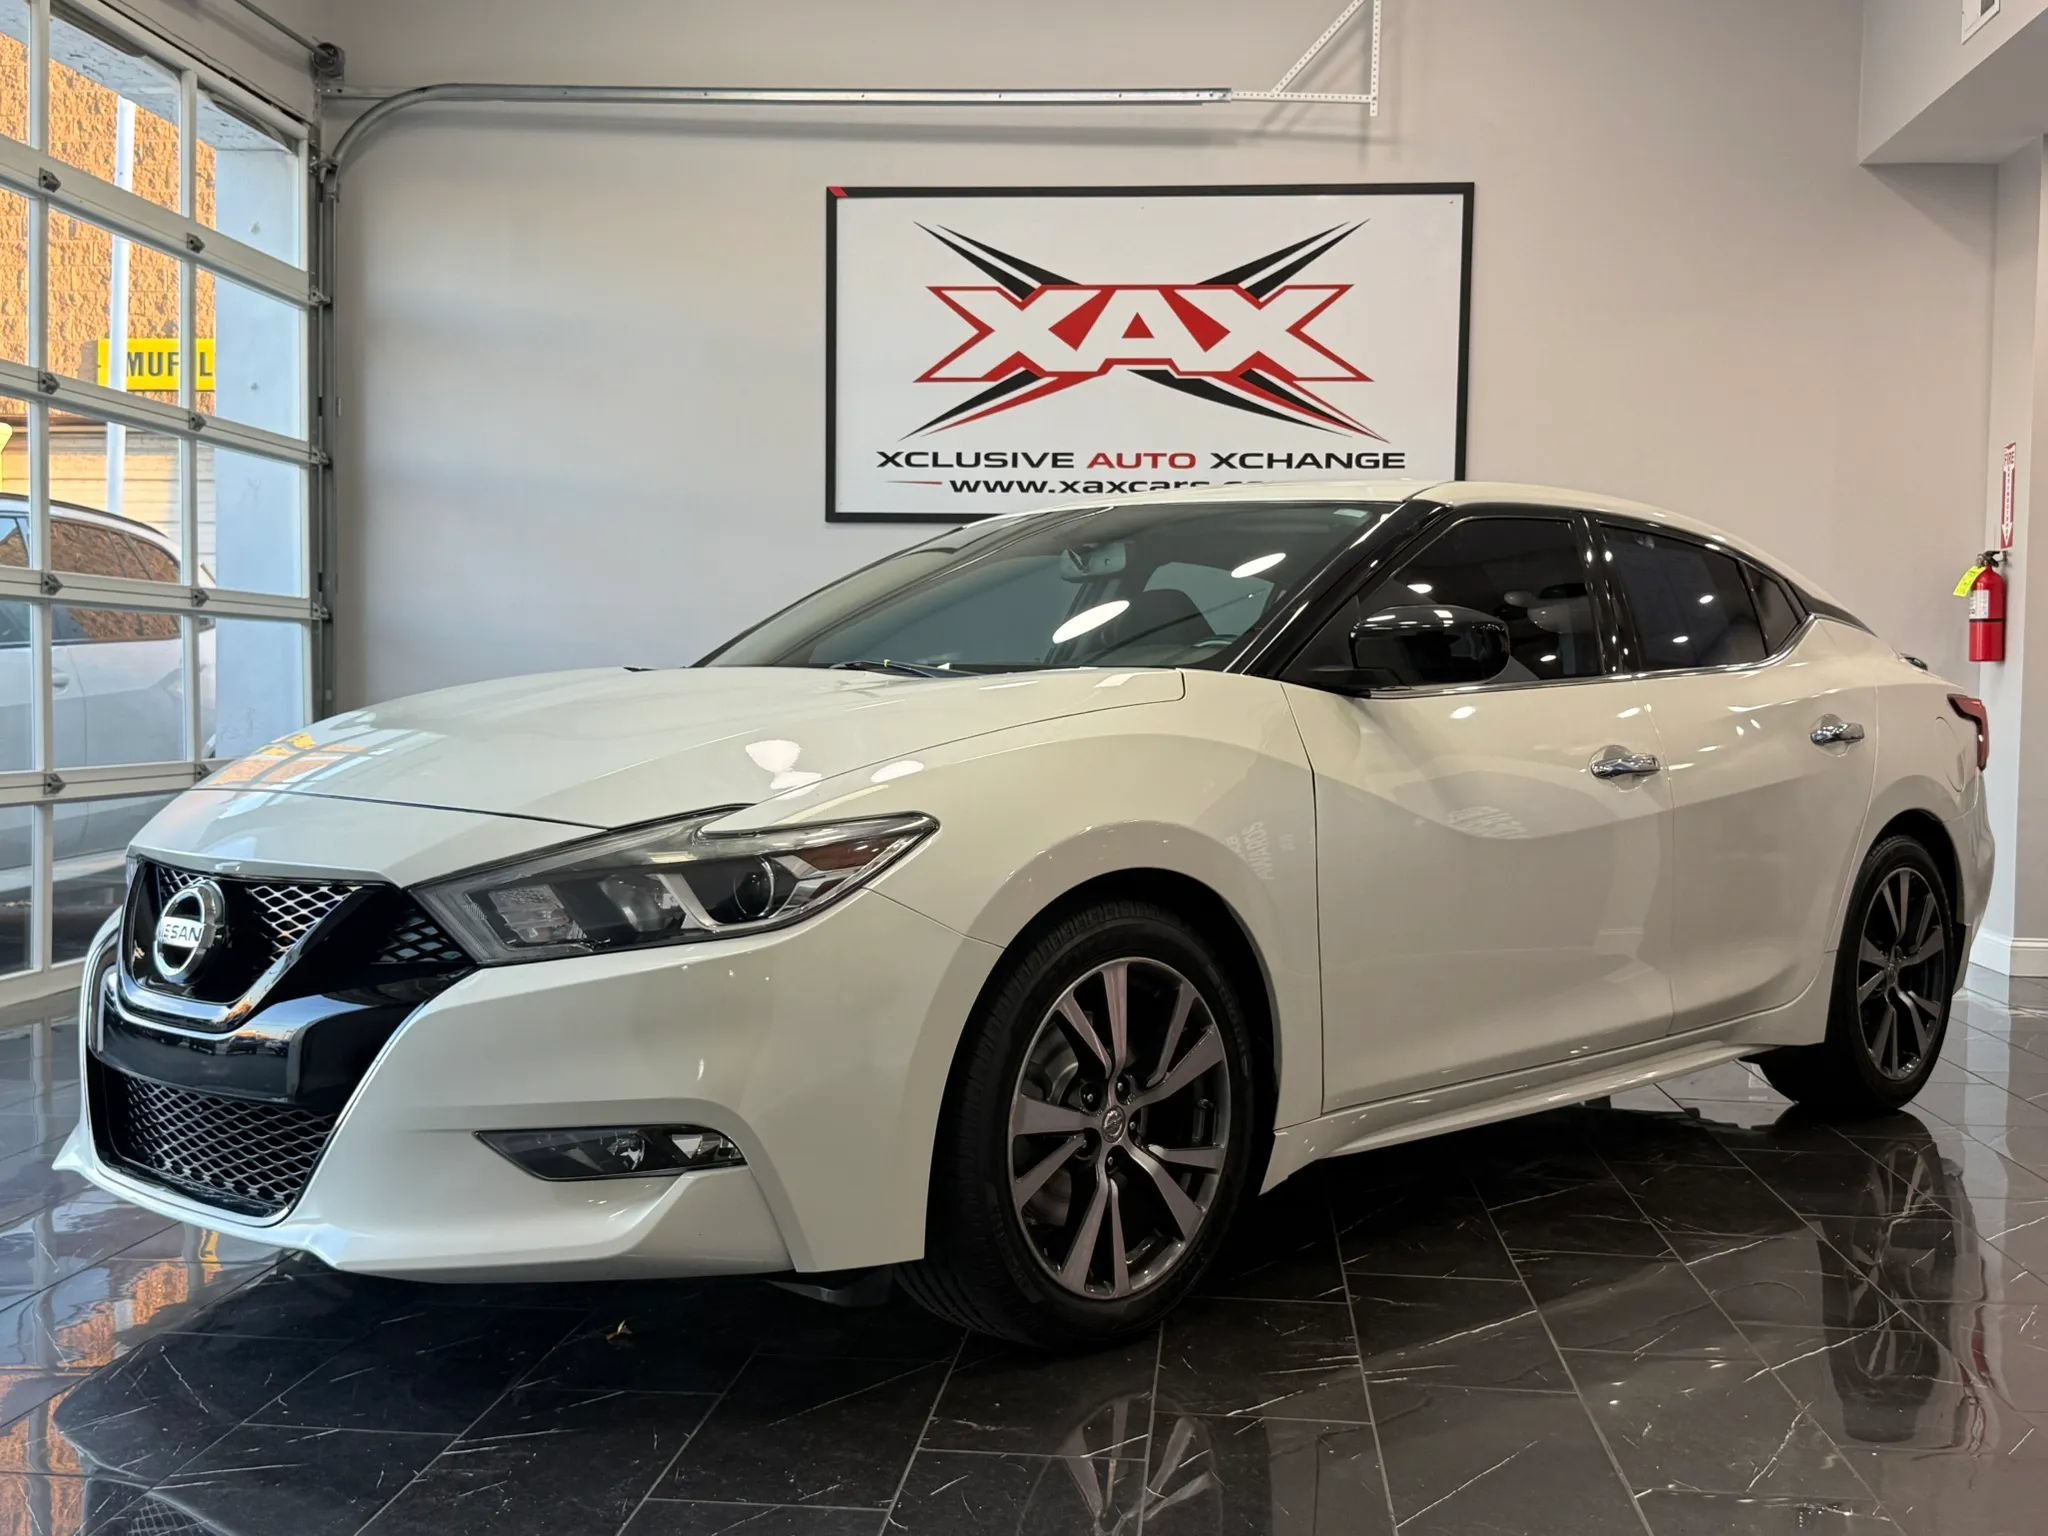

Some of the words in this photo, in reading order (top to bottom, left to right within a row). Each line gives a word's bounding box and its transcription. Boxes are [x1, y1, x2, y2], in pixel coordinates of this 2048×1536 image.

[914, 284, 1375, 383] XAX
[127, 351, 213, 376] MUFL
[876, 451, 1075, 469] XCLUSIVE
[1087, 452, 1196, 469] AUTO
[1210, 453, 1406, 469] XCHANGE
